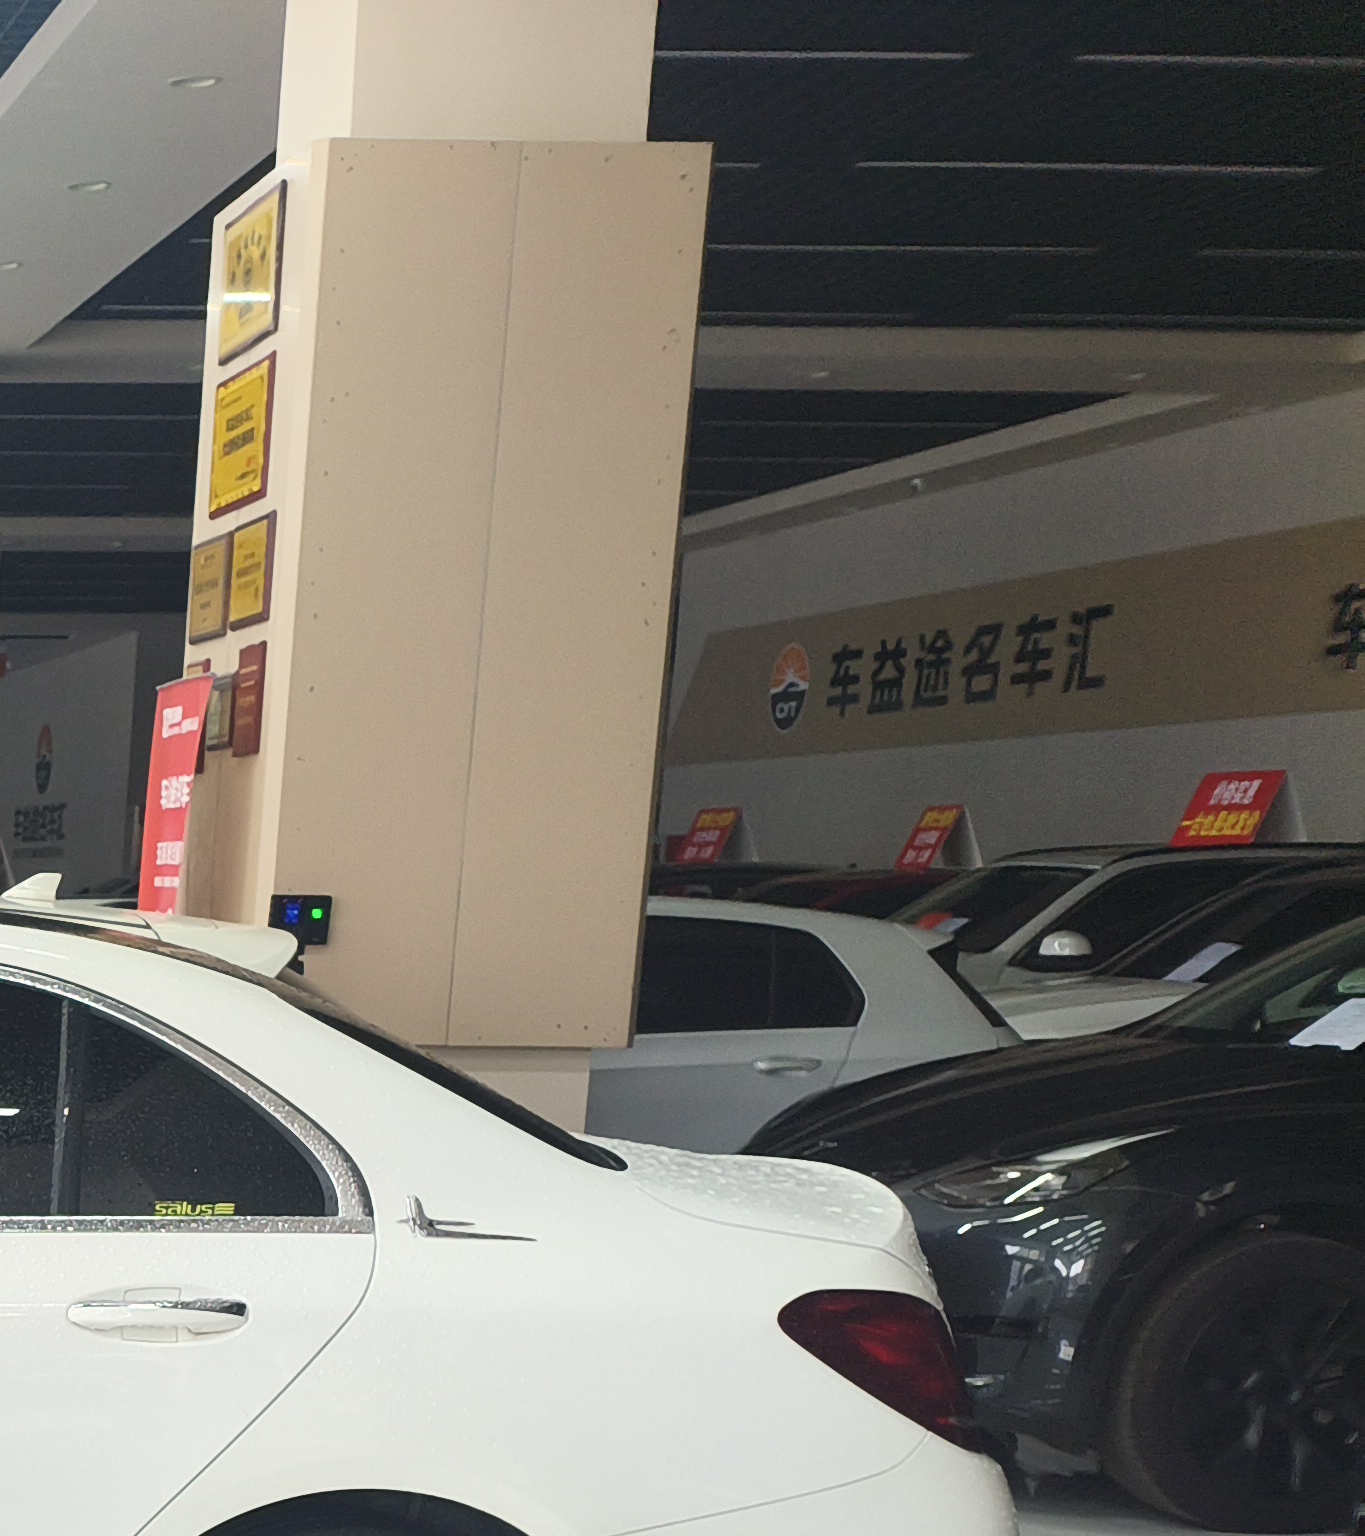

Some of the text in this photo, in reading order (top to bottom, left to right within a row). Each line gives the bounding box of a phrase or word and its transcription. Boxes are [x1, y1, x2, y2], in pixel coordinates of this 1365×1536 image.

[826, 603, 1115, 717] 车益途名车汇
